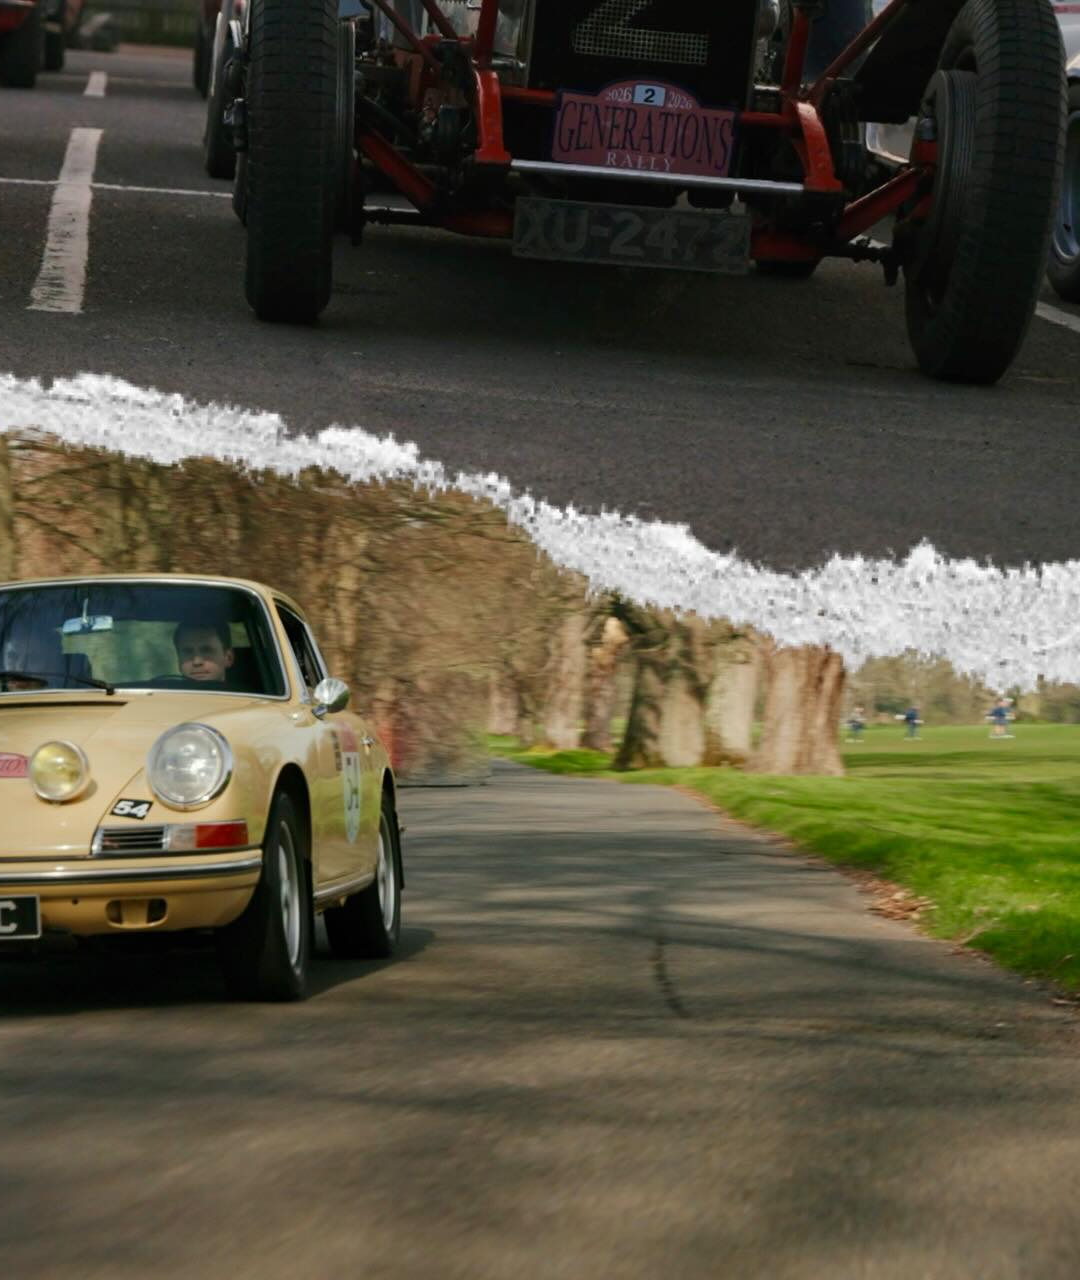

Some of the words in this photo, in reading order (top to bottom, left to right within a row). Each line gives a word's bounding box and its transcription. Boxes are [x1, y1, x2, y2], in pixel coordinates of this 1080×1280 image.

[605, 87, 633, 102] 2026
[643, 88, 656, 103] 2
[557, 101, 733, 170] GENERATIONS
[605, 151, 676, 172] RALLY
[112, 800, 150, 818] 54
